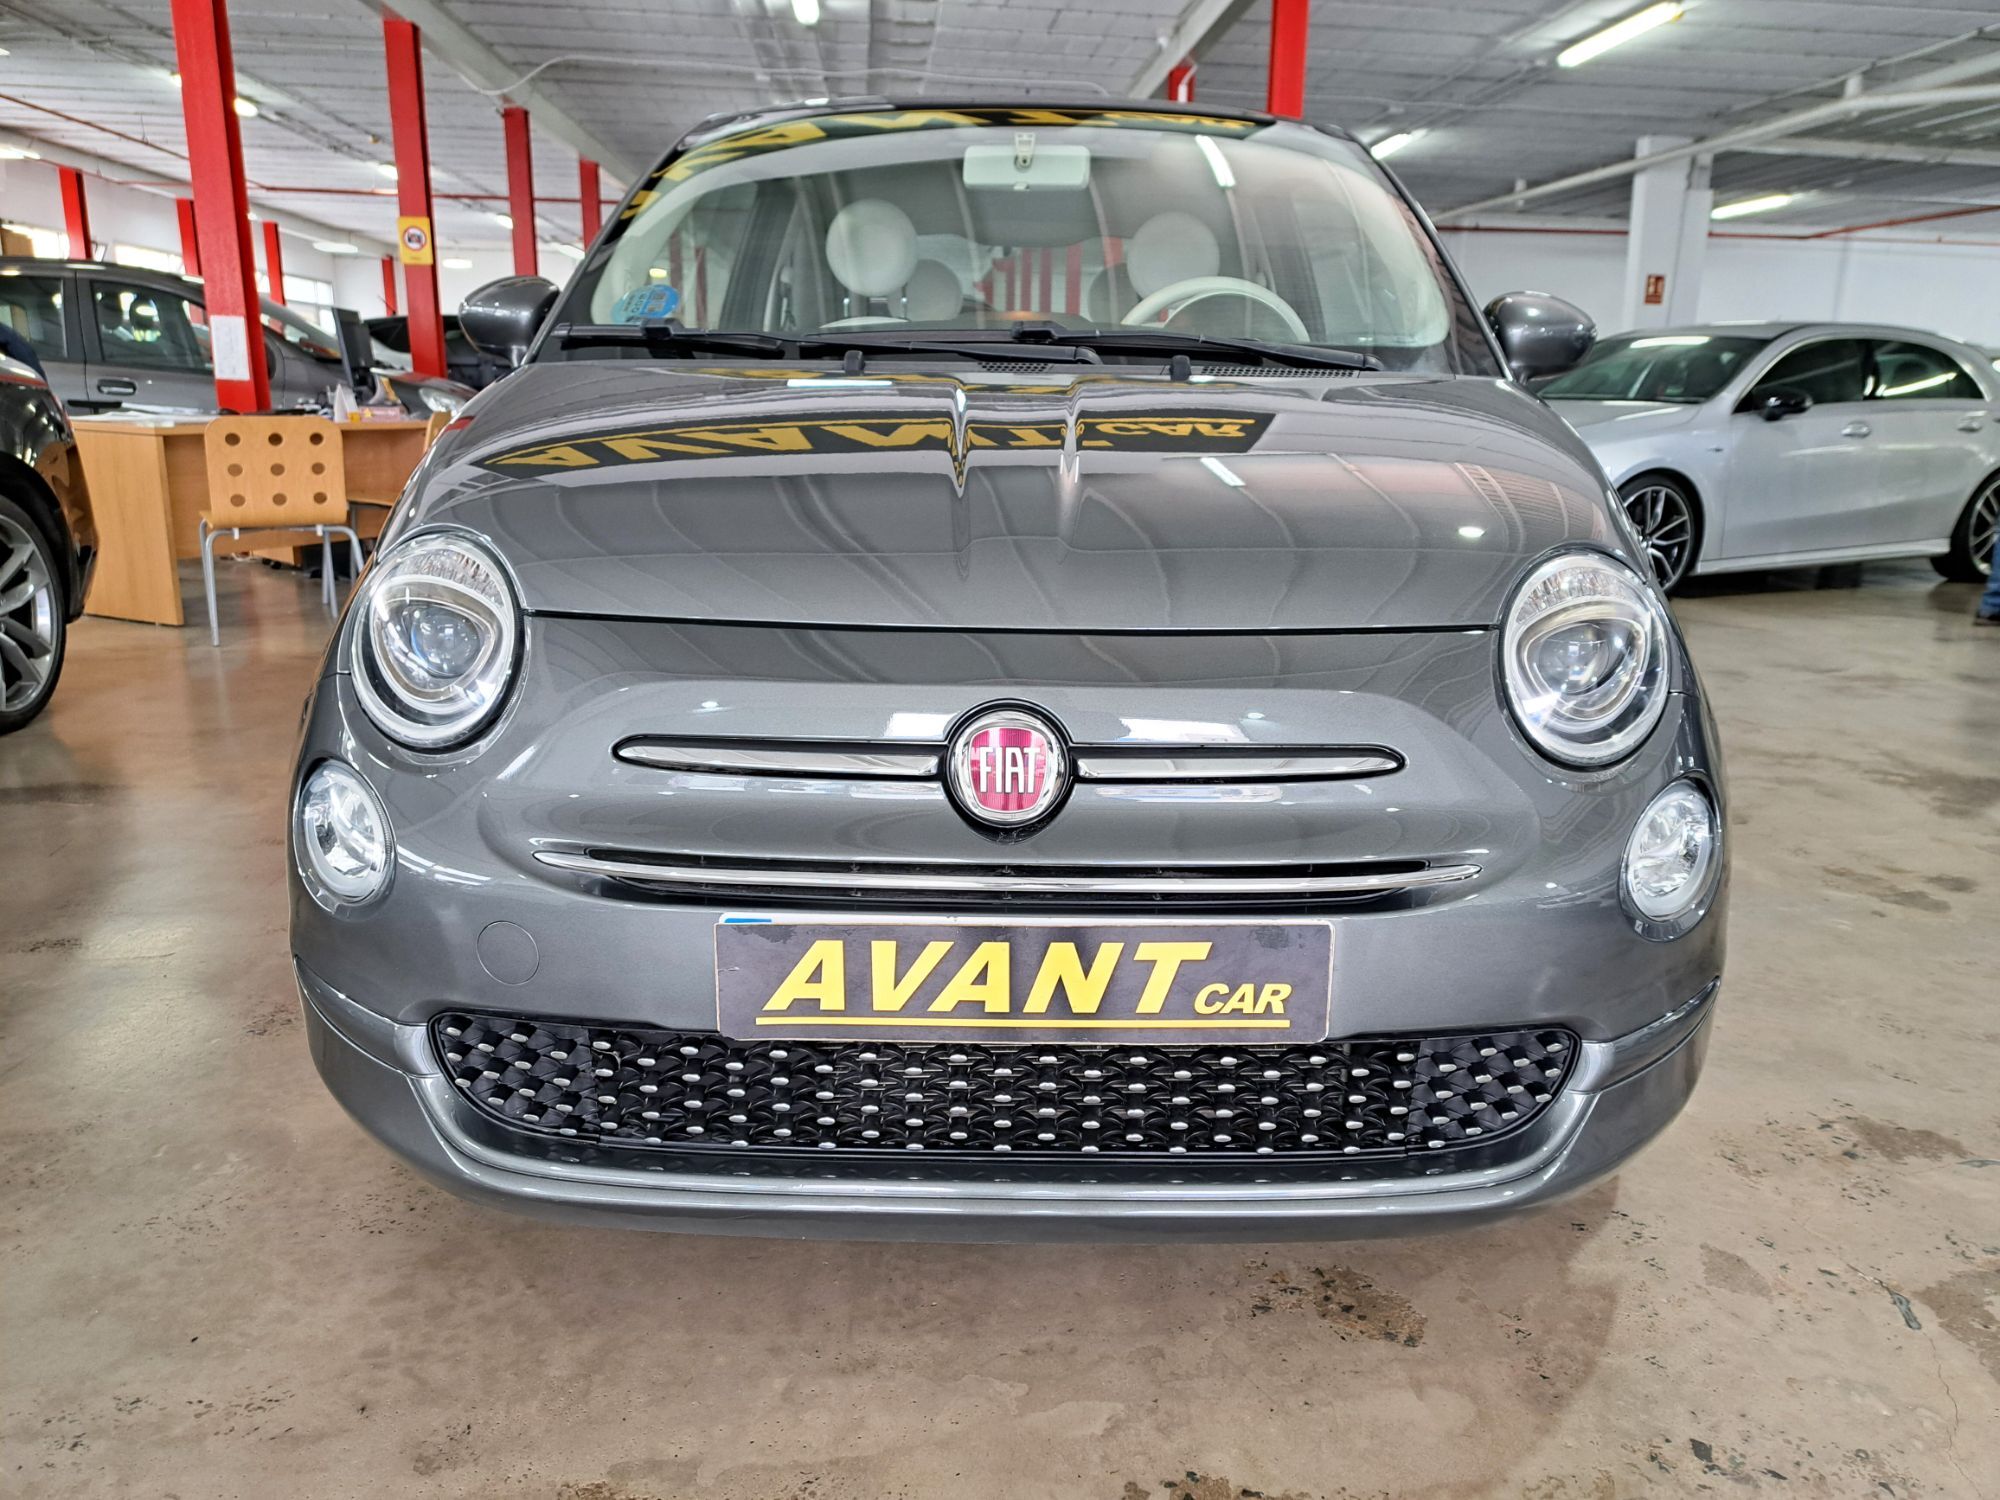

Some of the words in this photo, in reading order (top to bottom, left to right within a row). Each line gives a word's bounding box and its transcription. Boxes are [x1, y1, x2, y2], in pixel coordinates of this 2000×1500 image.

[979, 746, 1041, 793] FIAT
[762, 940, 1212, 1013] AVANT
[1193, 983, 1292, 1014] CAR
